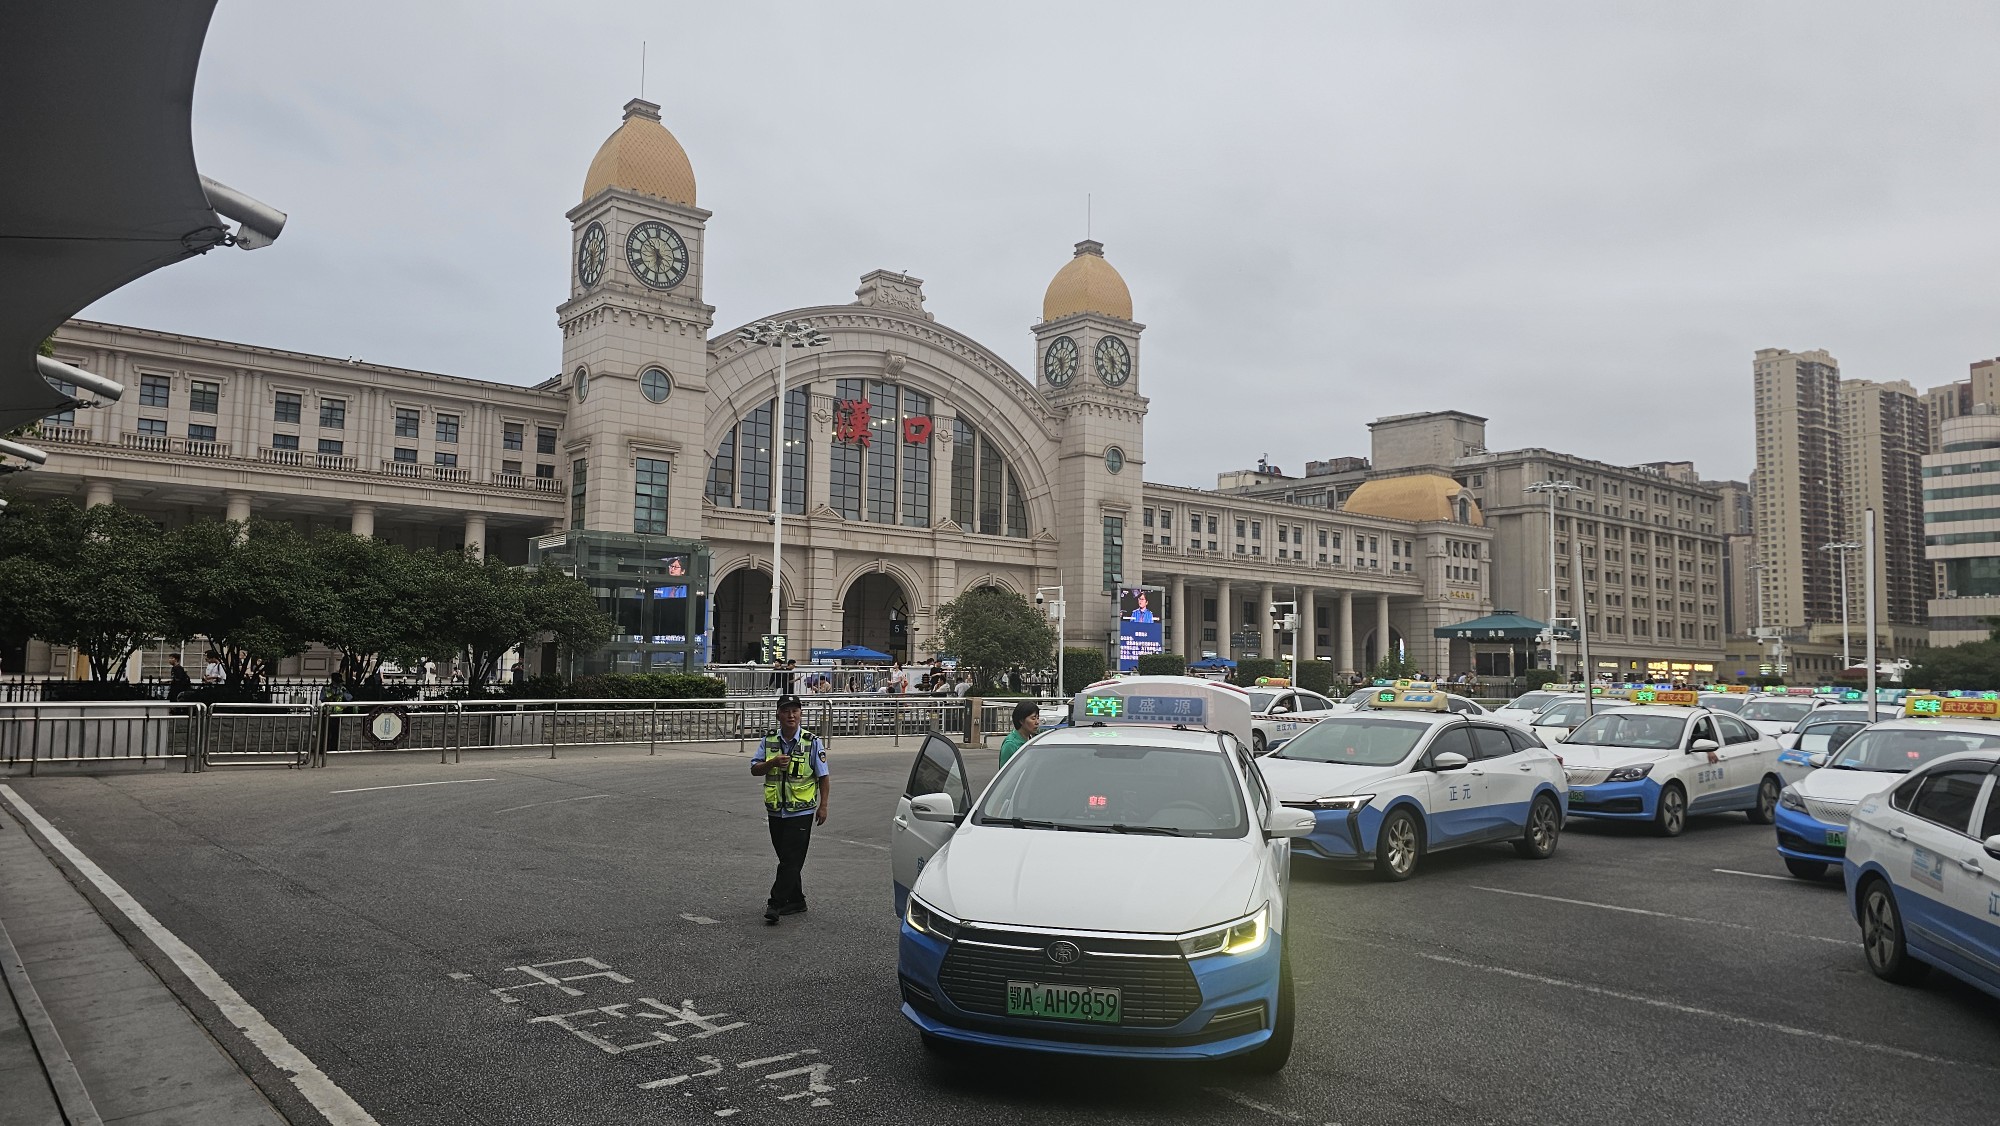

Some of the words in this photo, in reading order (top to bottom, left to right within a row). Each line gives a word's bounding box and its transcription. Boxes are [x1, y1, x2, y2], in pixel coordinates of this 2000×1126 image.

[1658, 692, 1693, 702] 武汉大通
[1086, 696, 1122, 717] 空车
[1138, 698, 1191, 715] 盛源
[1913, 699, 1941, 713] 空车
[1943, 702, 1995, 713] 武汉大通
[1449, 784, 1471, 801] 正元
